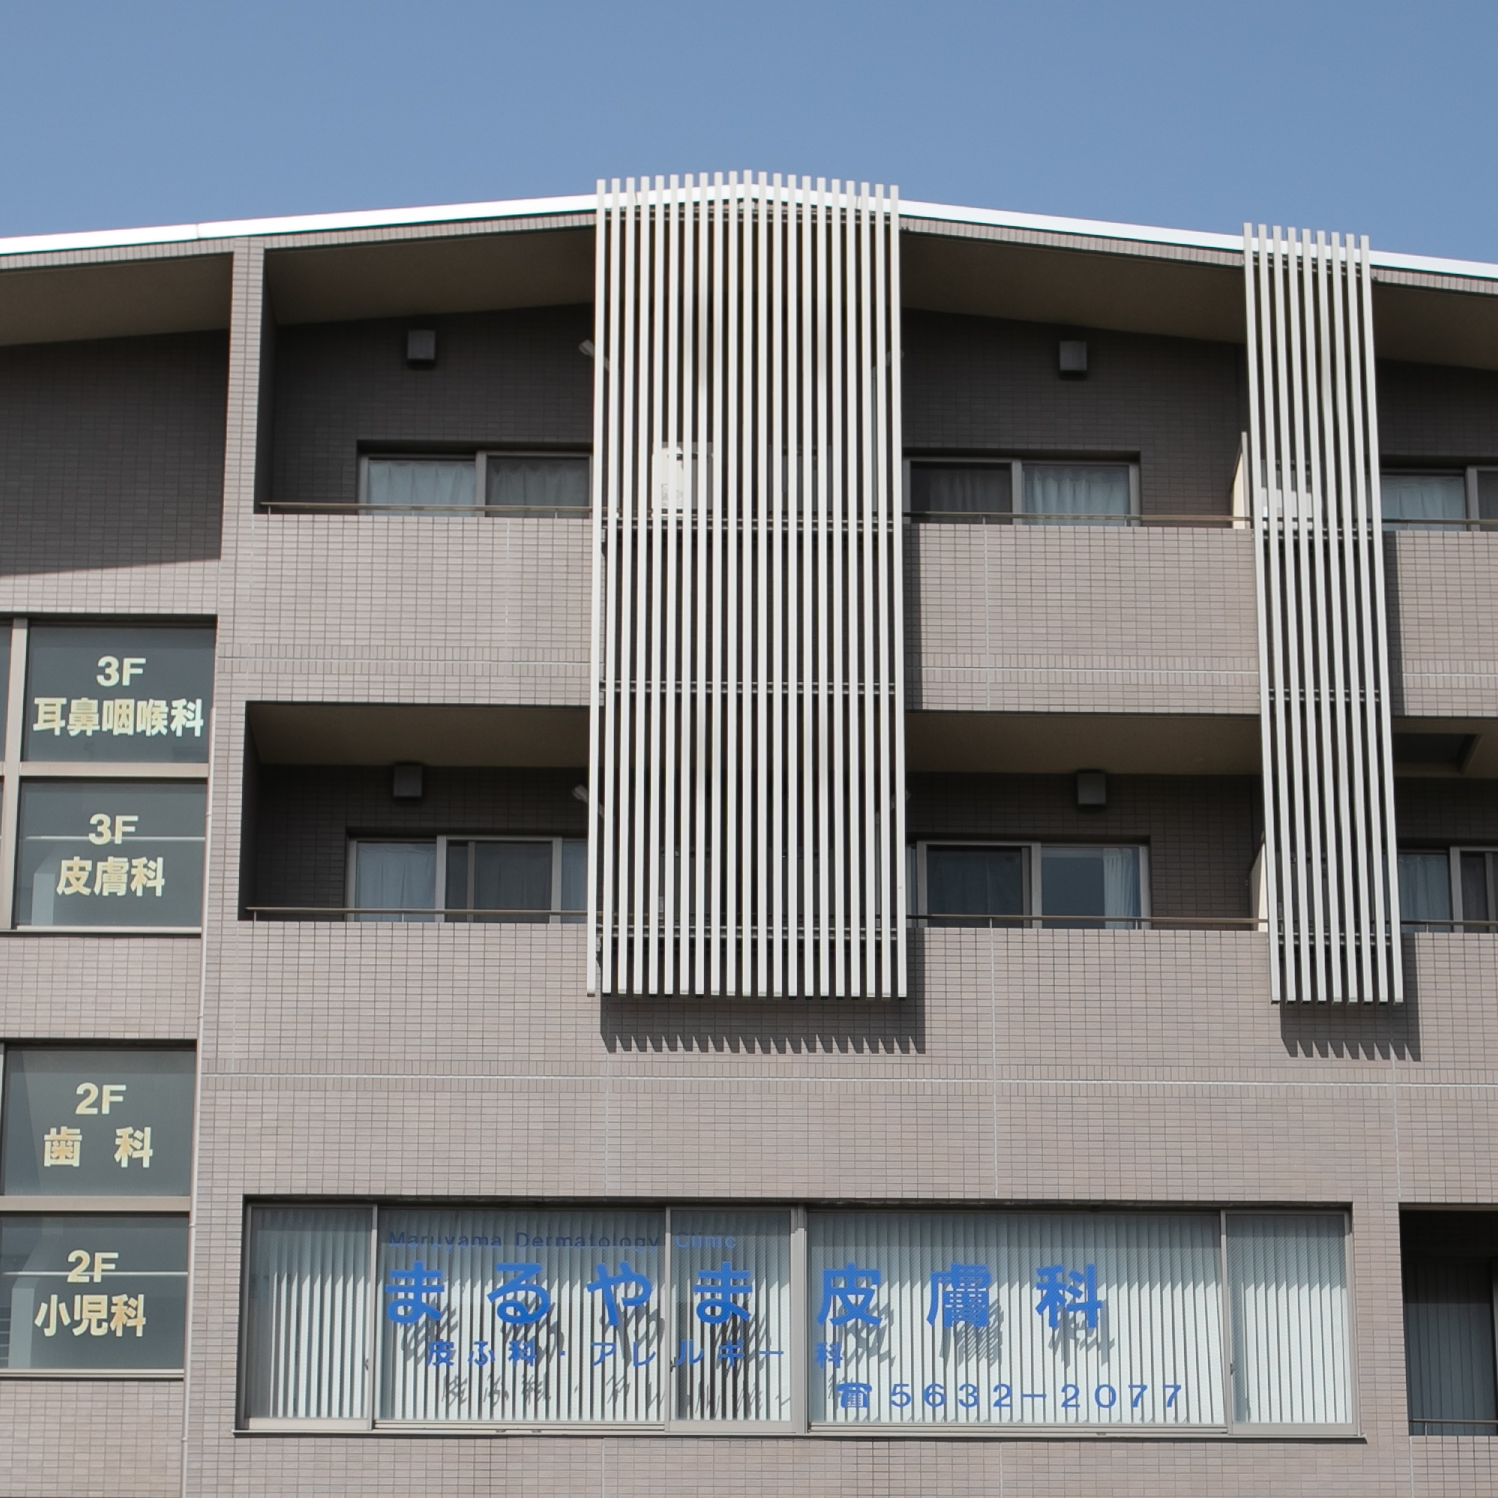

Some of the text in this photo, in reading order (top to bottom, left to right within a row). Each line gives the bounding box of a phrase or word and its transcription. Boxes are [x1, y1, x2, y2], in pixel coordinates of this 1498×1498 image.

[96, 656, 146, 686] 3F
[33, 697, 203, 737] 耳鼻咽喉科
[88, 813, 139, 845] 3F
[56, 856, 165, 897] 皮膚科
[75, 1082, 126, 1115] 2F
[388, 1231, 737, 1253] Maruyama Dermatology Clinic
[67, 1250, 119, 1283] 2F
[34, 1294, 146, 1337] 小児科
